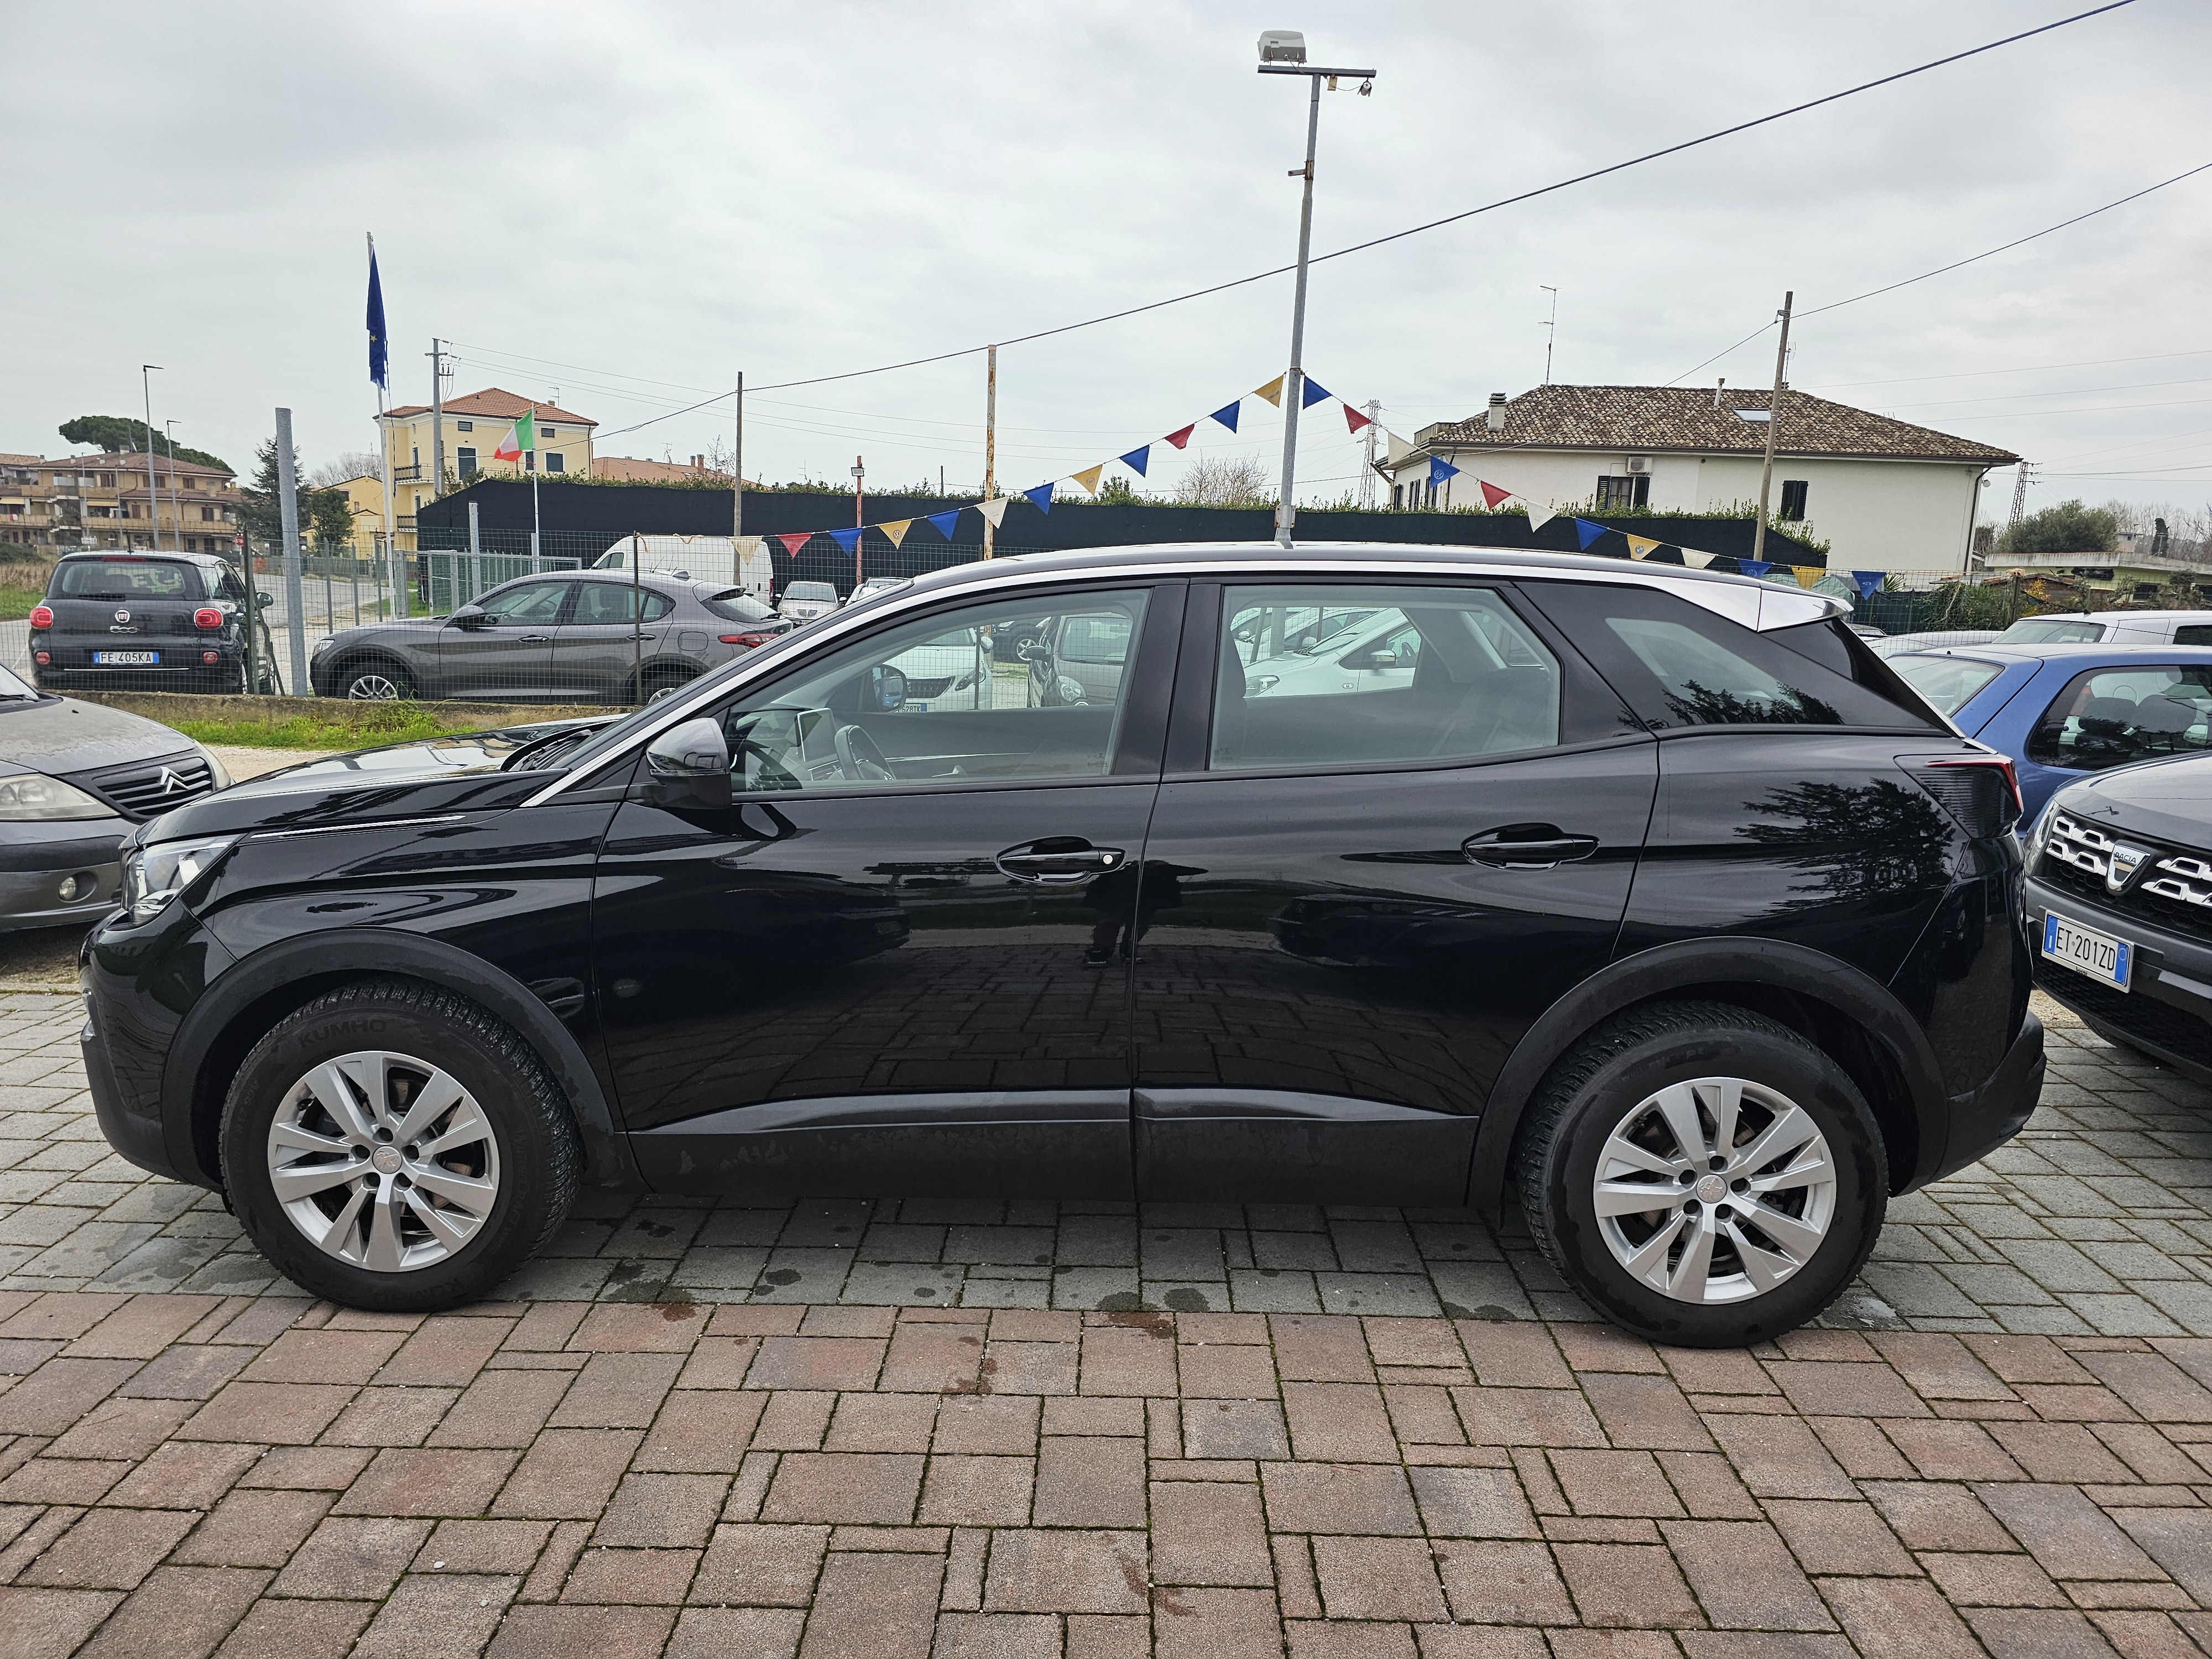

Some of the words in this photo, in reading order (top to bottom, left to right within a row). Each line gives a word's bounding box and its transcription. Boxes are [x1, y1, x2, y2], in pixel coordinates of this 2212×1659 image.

[101, 653, 114, 662] FE
[118, 653, 151, 662] 405KA
[2115, 852, 2136, 864] DACIA
[2056, 926, 2072, 953] ET
[2074, 935, 2116, 971] 201ZD
[298, 1019, 387, 1048] KUMHO
